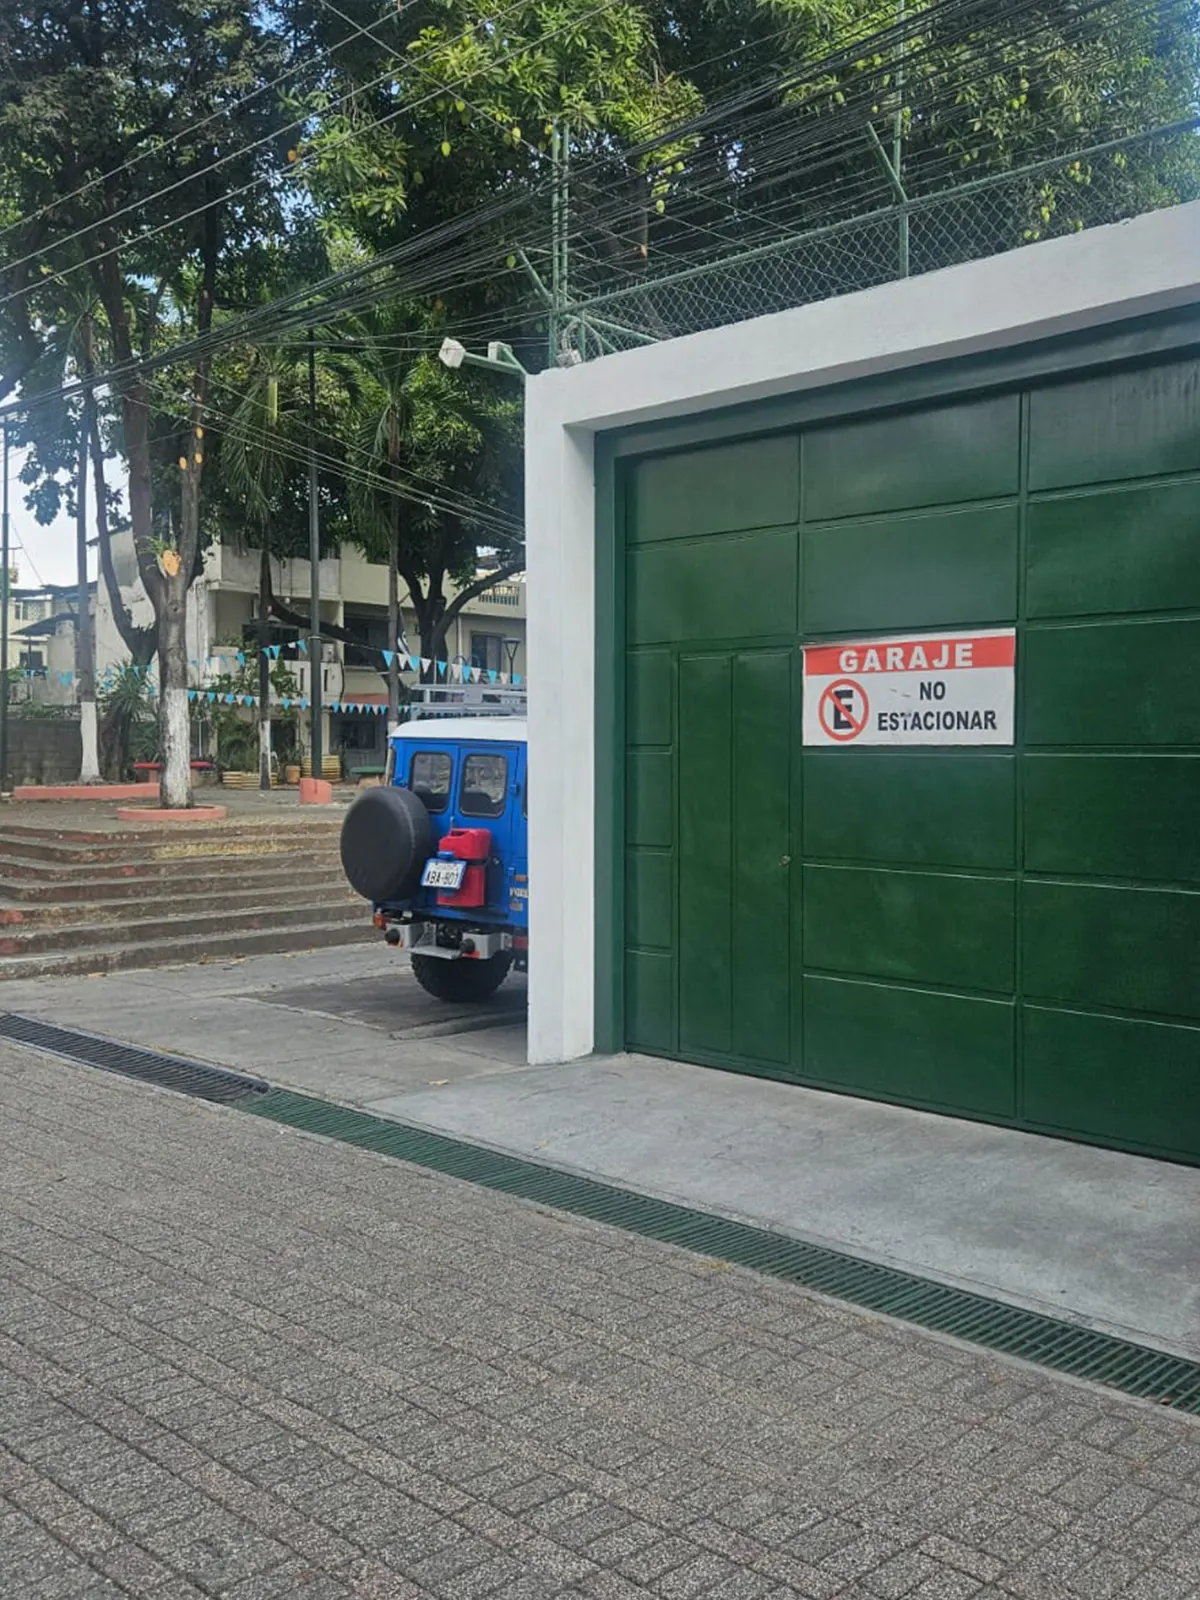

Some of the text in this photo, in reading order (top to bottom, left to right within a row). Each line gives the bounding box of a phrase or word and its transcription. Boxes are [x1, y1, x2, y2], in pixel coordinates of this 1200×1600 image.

[839, 643, 973, 673] GARAJE
[919, 681, 946, 701] NO
[833, 689, 854, 730] E
[877, 710, 997, 731] ESTACIONAR
